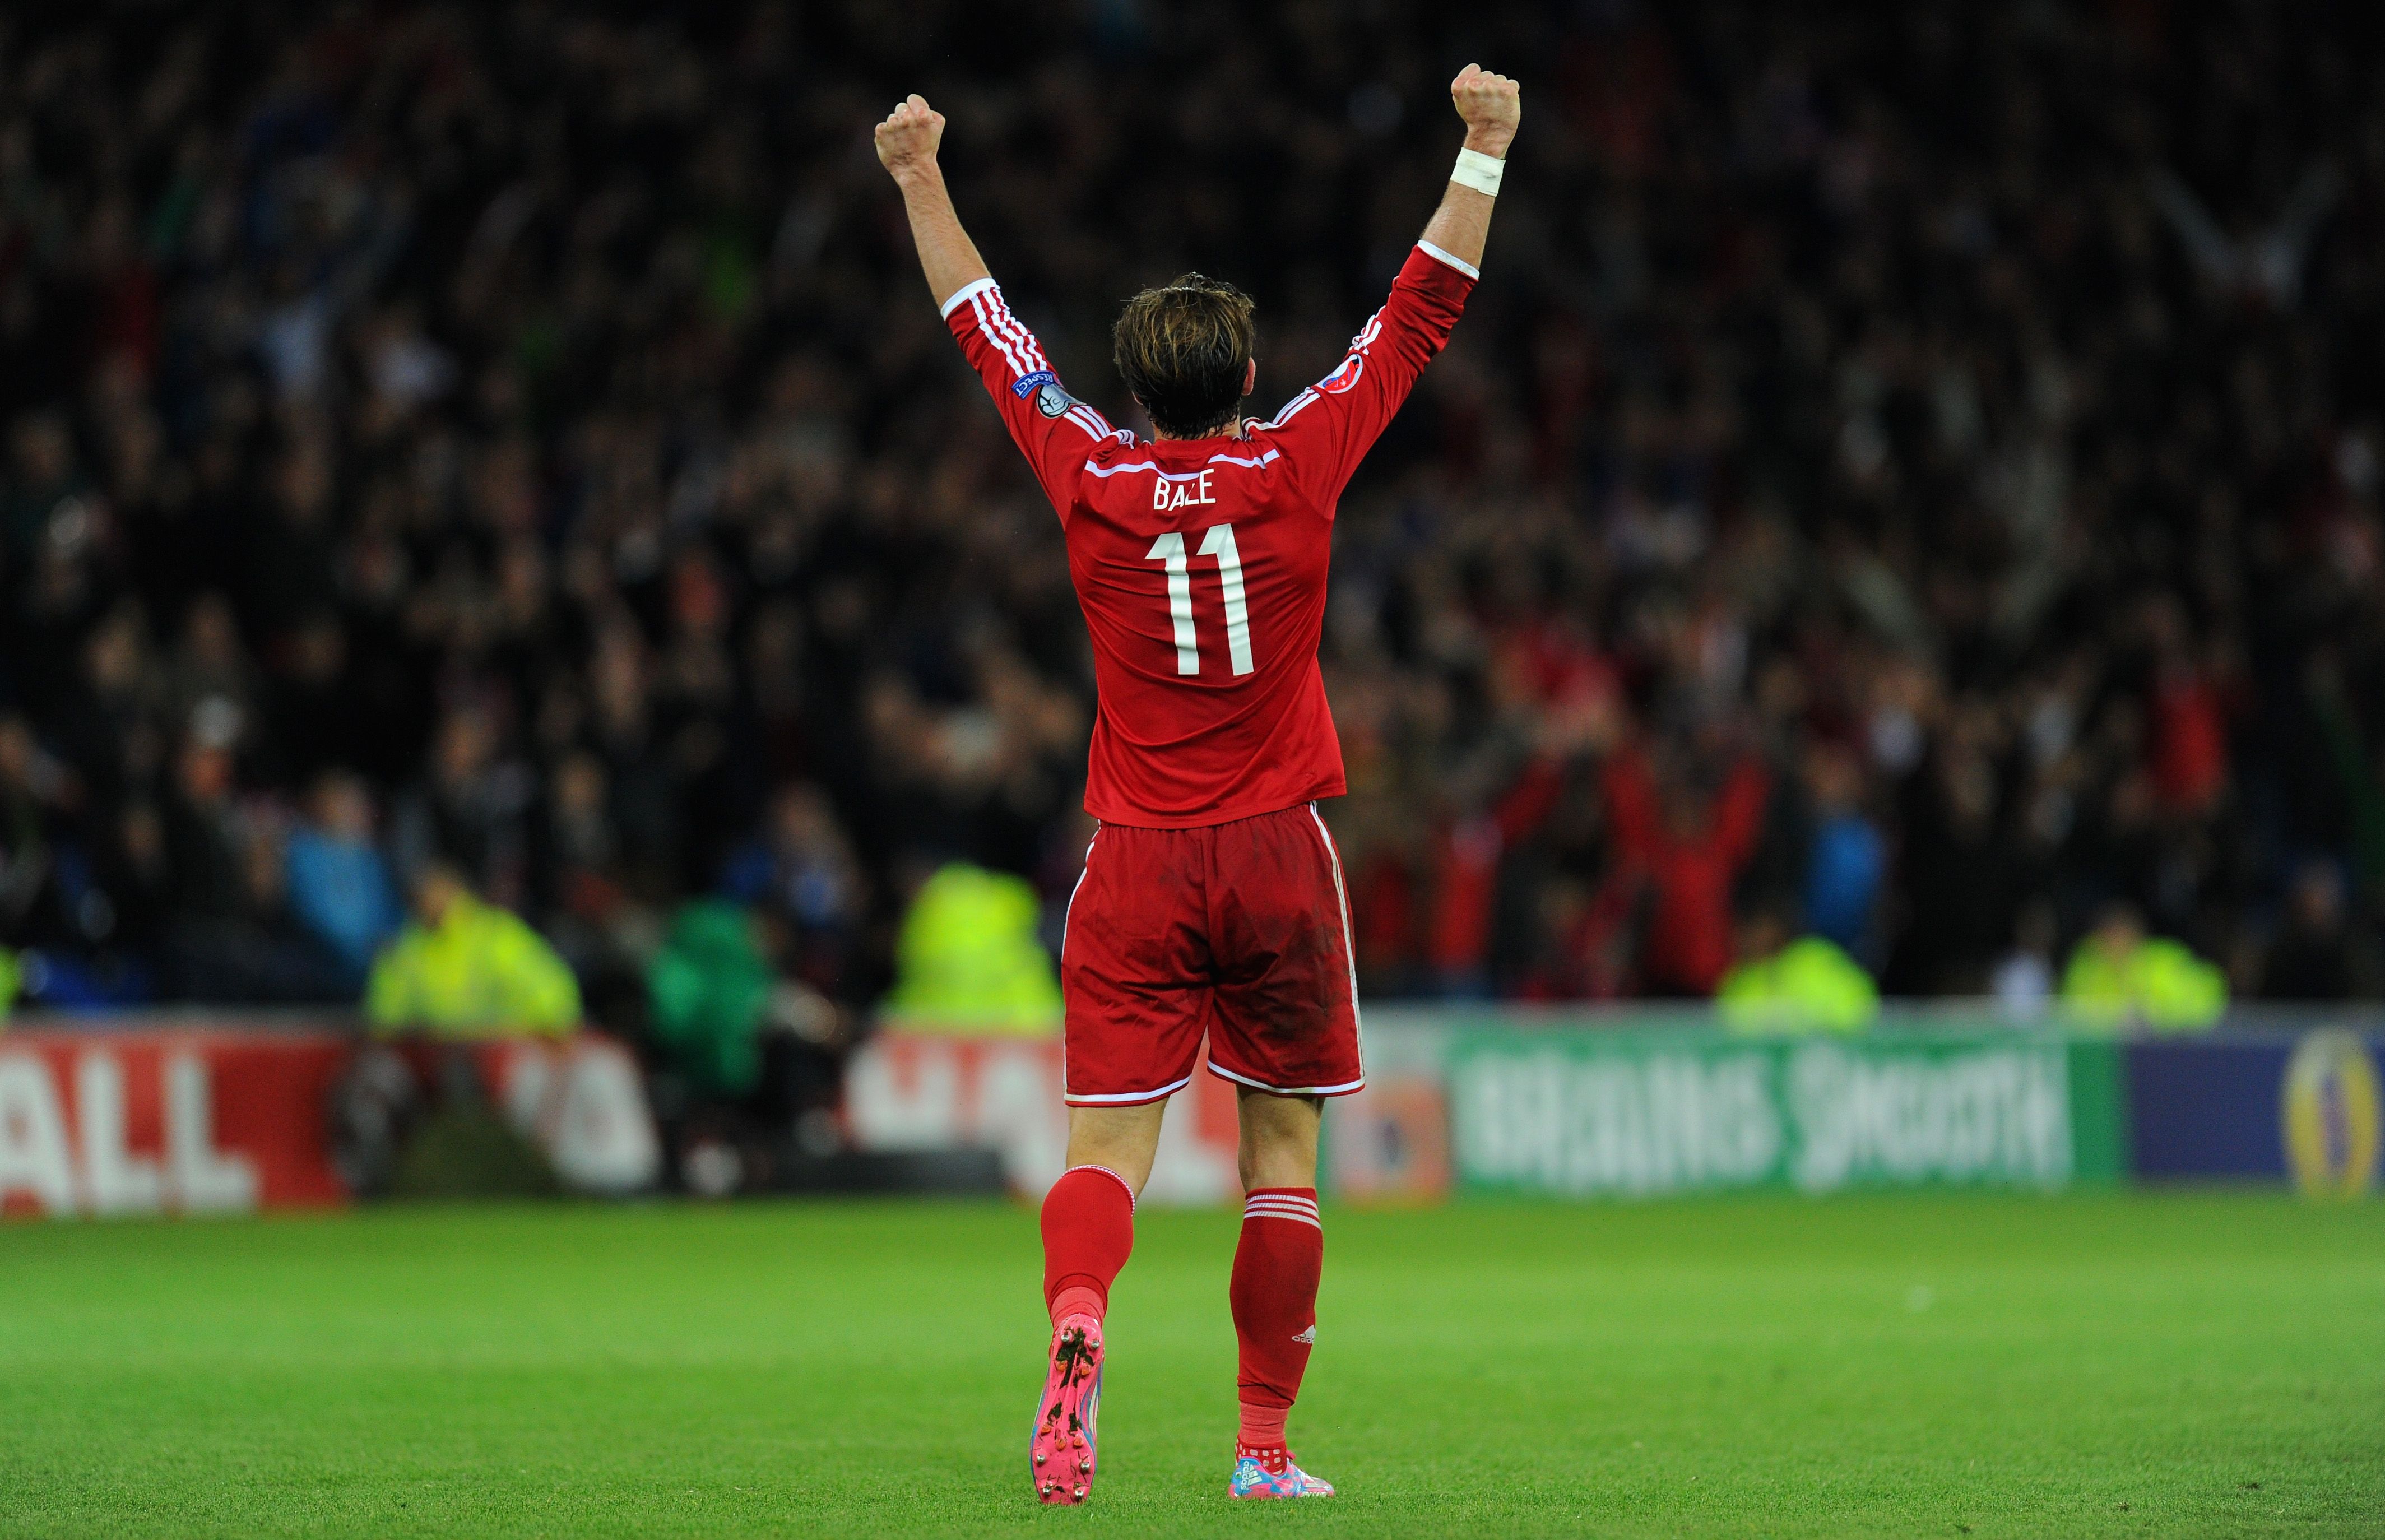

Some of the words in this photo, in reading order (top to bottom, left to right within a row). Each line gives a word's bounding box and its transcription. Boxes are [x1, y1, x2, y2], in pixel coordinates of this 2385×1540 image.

[1015, 373, 1054, 396] RESPECT
[1153, 468, 1216, 511] BALE
[1145, 523, 1254, 676] 11
[1240, 1460, 1250, 1490] adidas
